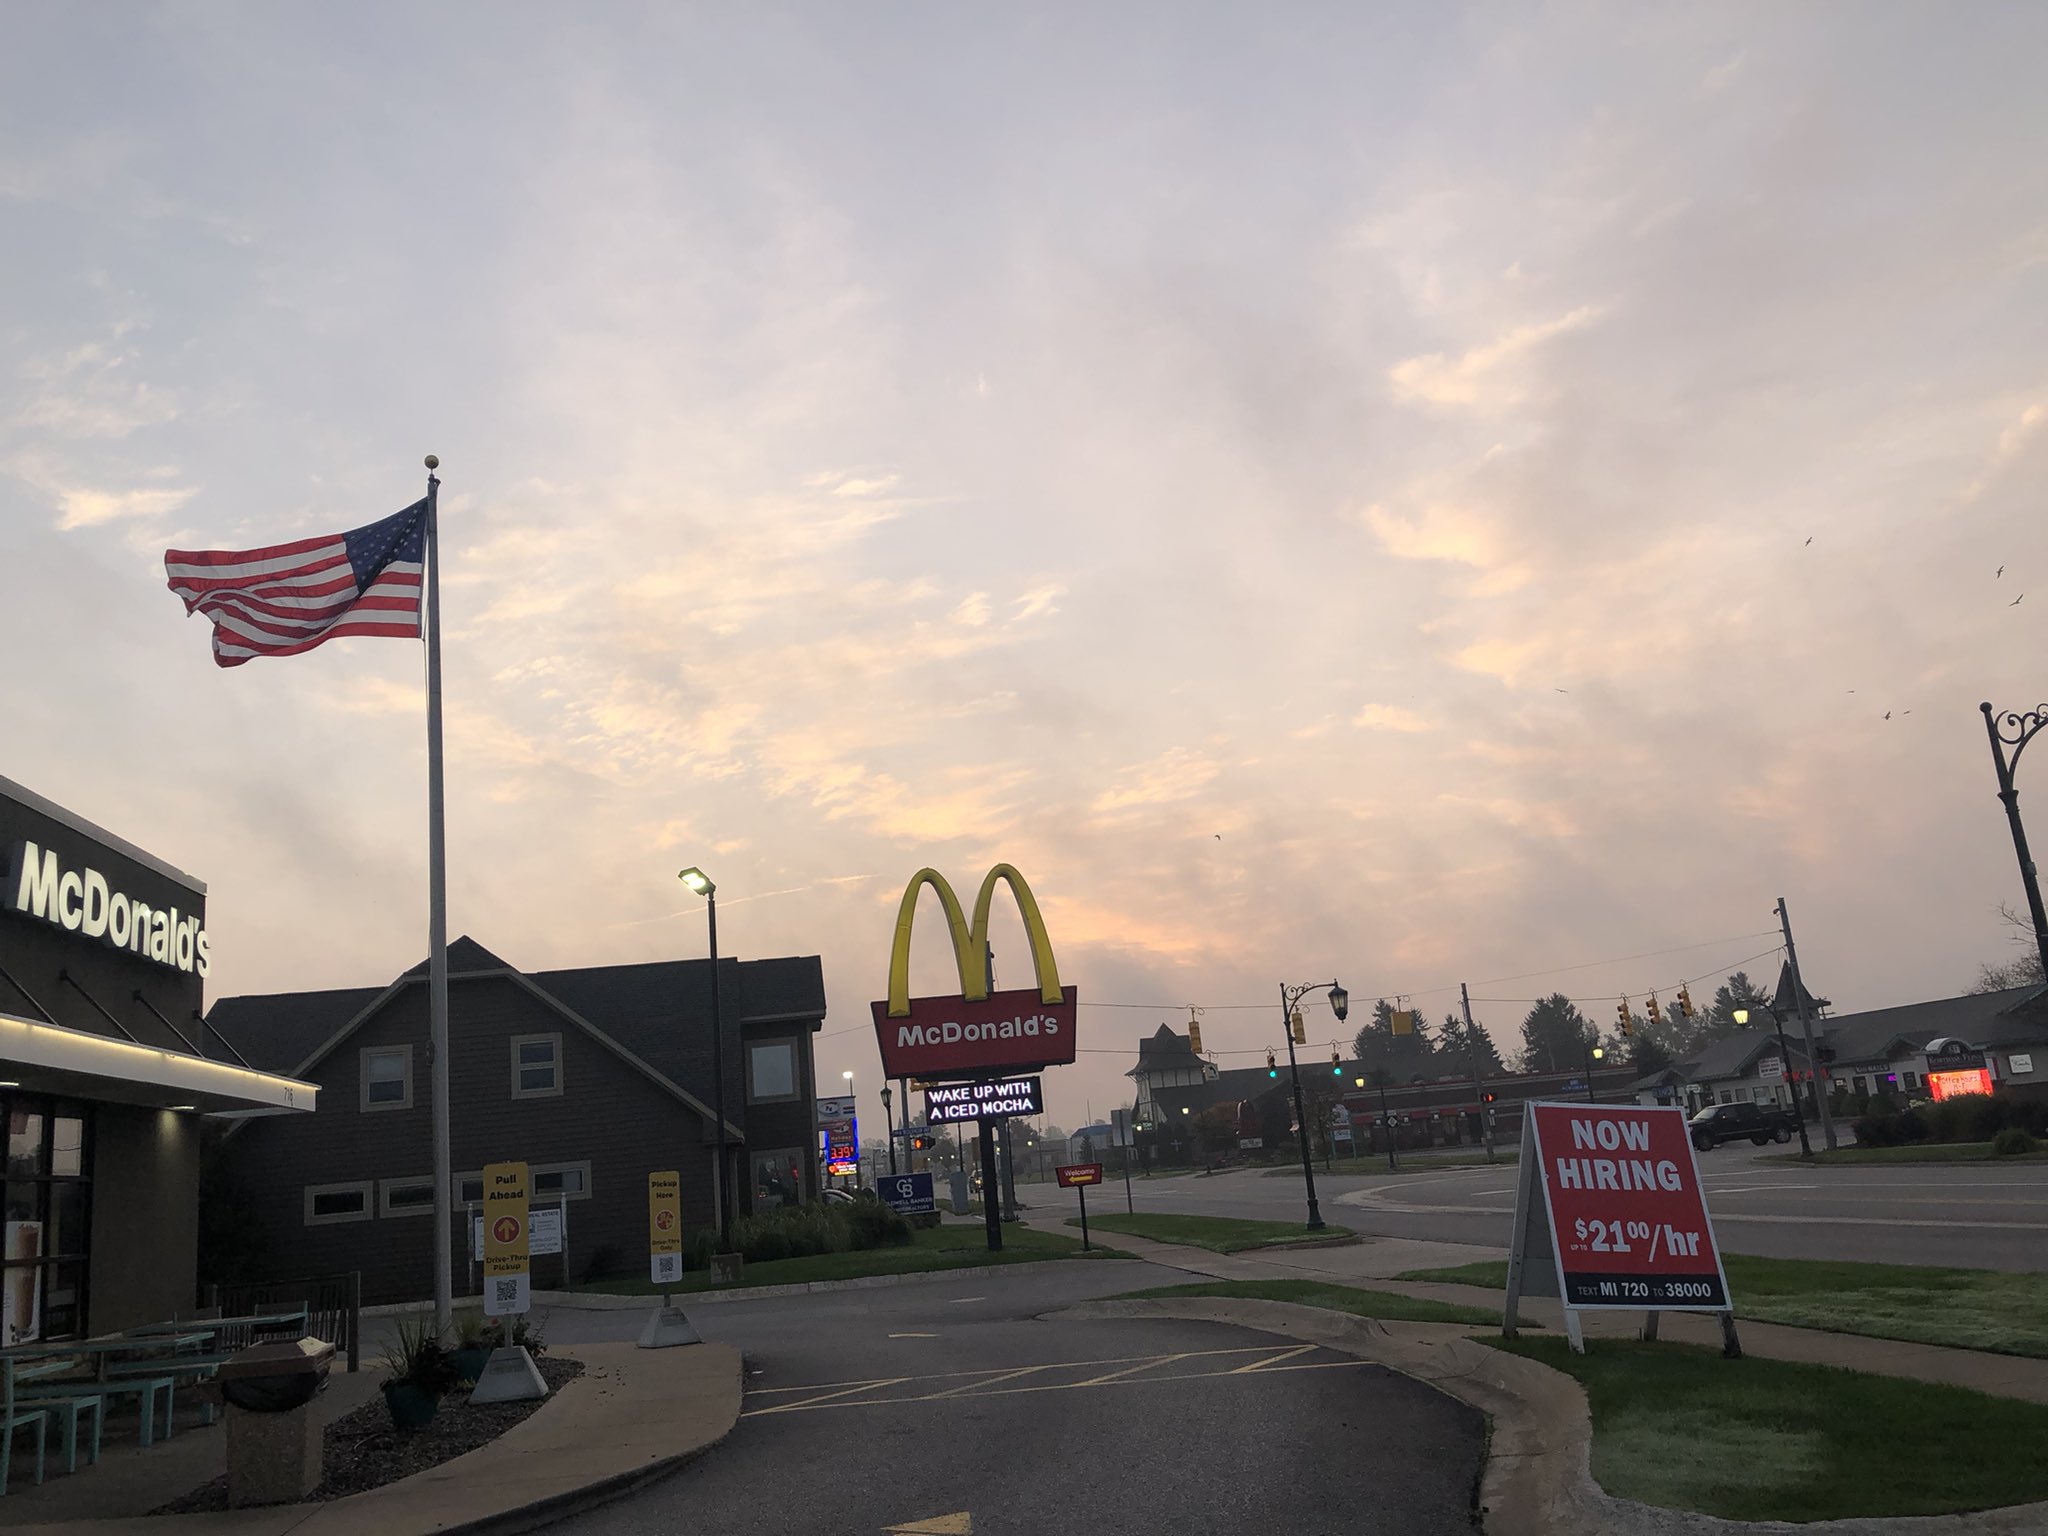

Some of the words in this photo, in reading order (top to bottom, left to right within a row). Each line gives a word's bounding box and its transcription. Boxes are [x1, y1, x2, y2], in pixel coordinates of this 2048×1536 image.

[16, 840, 211, 978] McDonald's
[897, 1014, 1059, 1047] McDonald's
[929, 1088, 970, 1103] WAKE
[974, 1086, 994, 1099] UP
[994, 1081, 1031, 1098] WITH
[930, 1107, 942, 1120] A
[945, 1104, 978, 1118] ICED
[982, 1098, 1033, 1115] MOCHA
[1571, 1119, 1649, 1151] NOW
[1064, 1168, 1095, 1176] Welcome
[1556, 1158, 1683, 1191] HIRING
[496, 1175, 517, 1185] Pull
[489, 1189, 524, 1201] Ahead
[910, 1196, 932, 1204] BANKER
[486, 1254, 528, 1264] Drive-Thru
[493, 1263, 520, 1271] Pickup
[1577, 1286, 1598, 1296] TEXT
[1600, 1282, 1617, 1296] MI
[1621, 1283, 1649, 1297] 720
[1652, 1288, 1664, 1297] TO
[1665, 1283, 1711, 1297] 38000
